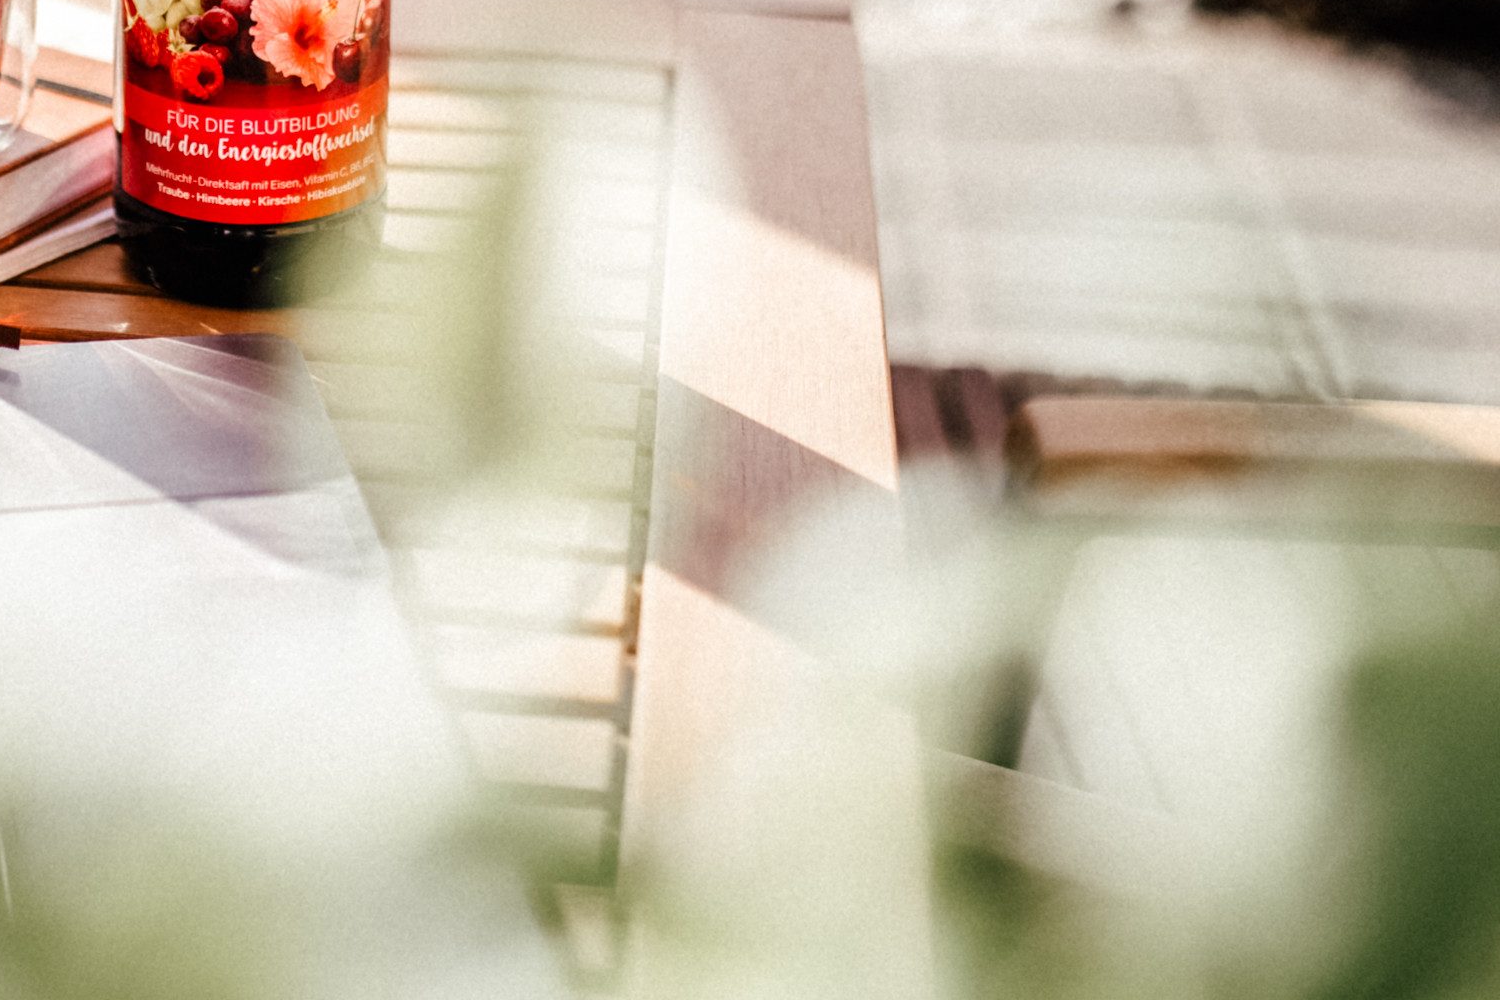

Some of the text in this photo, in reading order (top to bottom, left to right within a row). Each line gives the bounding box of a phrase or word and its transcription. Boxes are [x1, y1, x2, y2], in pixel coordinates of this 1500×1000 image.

[167, 103, 360, 135] FÜR DIE BLUTBILDUNG
[145, 115, 375, 167] und den Energiestoffwechsel
[251, 180, 268, 190] mit
[304, 170, 339, 186] Vitamin
[157, 182, 190, 200] Traube
[196, 193, 251, 206] Himbeere
[258, 194, 301, 207] Kirsche
